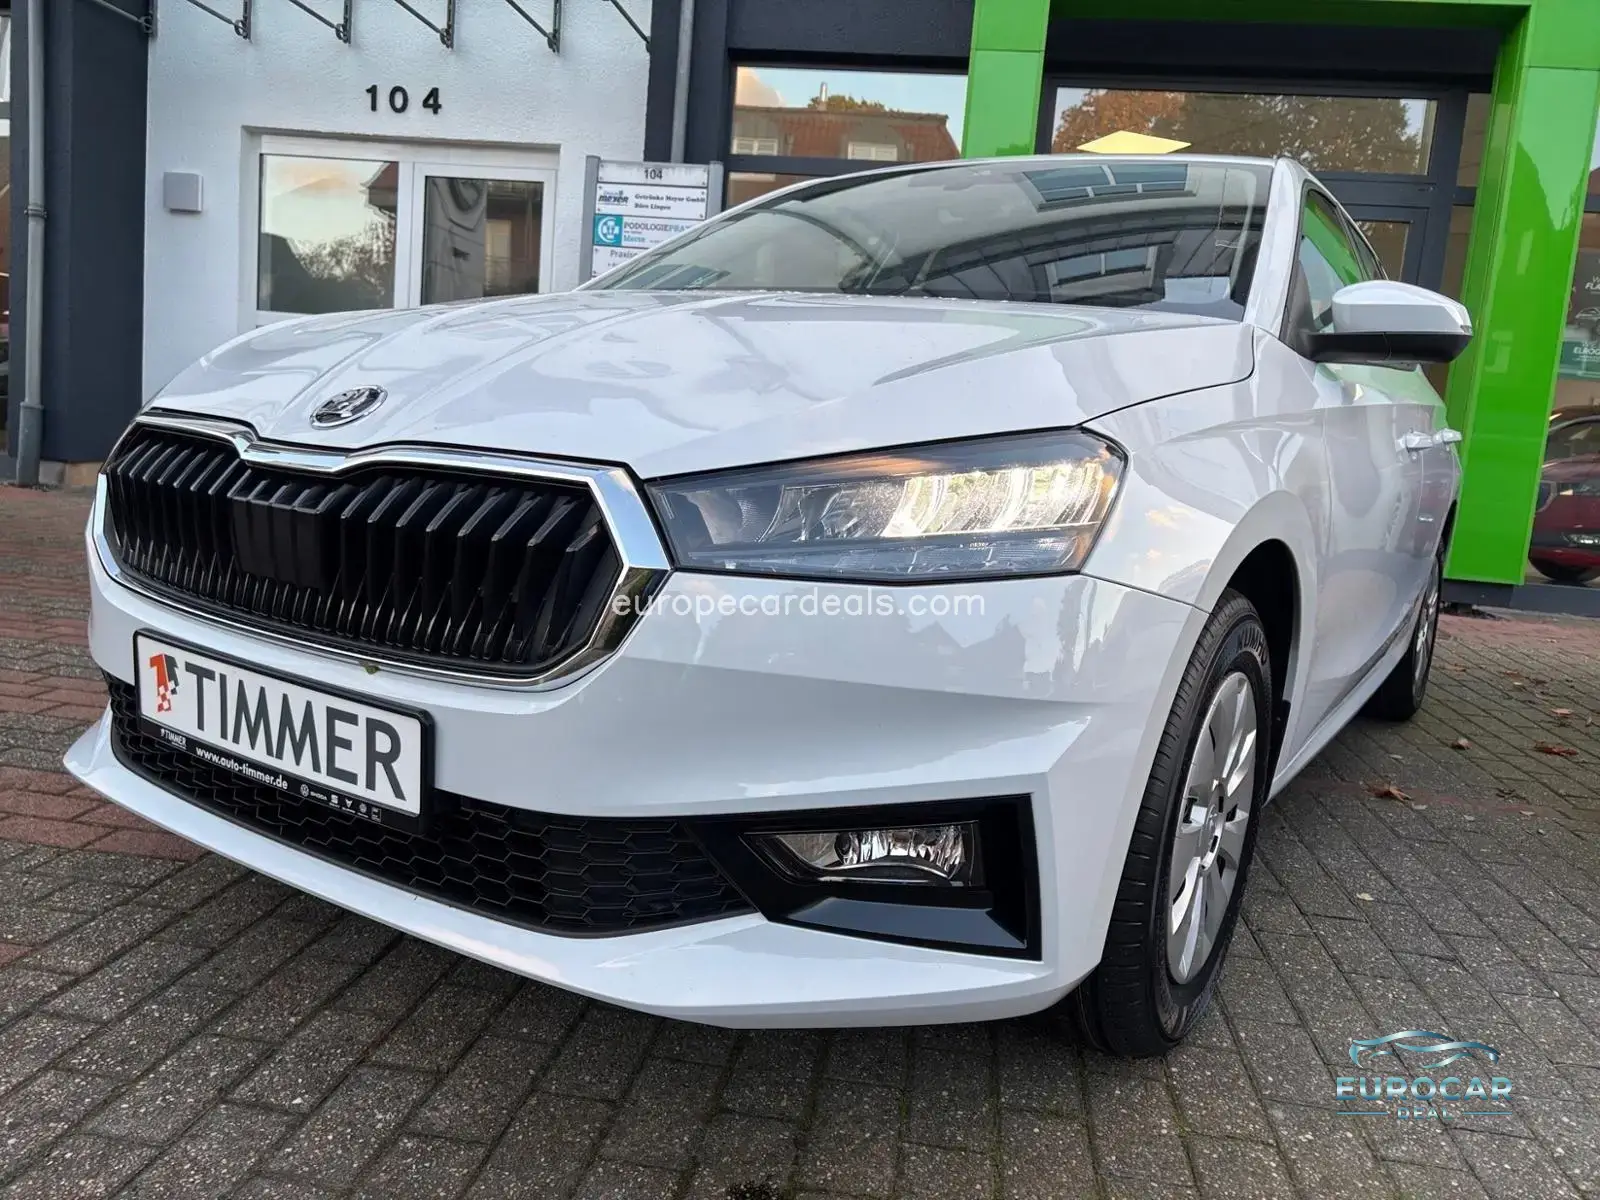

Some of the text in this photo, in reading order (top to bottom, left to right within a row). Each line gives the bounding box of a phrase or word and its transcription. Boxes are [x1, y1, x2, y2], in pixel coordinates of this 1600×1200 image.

[365, 84, 443, 115] 104
[644, 168, 663, 180] 104
[650, 203, 672, 212] Lingen
[665, 195, 685, 204] Meyer
[686, 195, 706, 203] GmbH
[164, 729, 187, 745] TIMMER
[185, 660, 407, 802] TIMMER
[195, 746, 288, 790] www.auto-timmer.de
